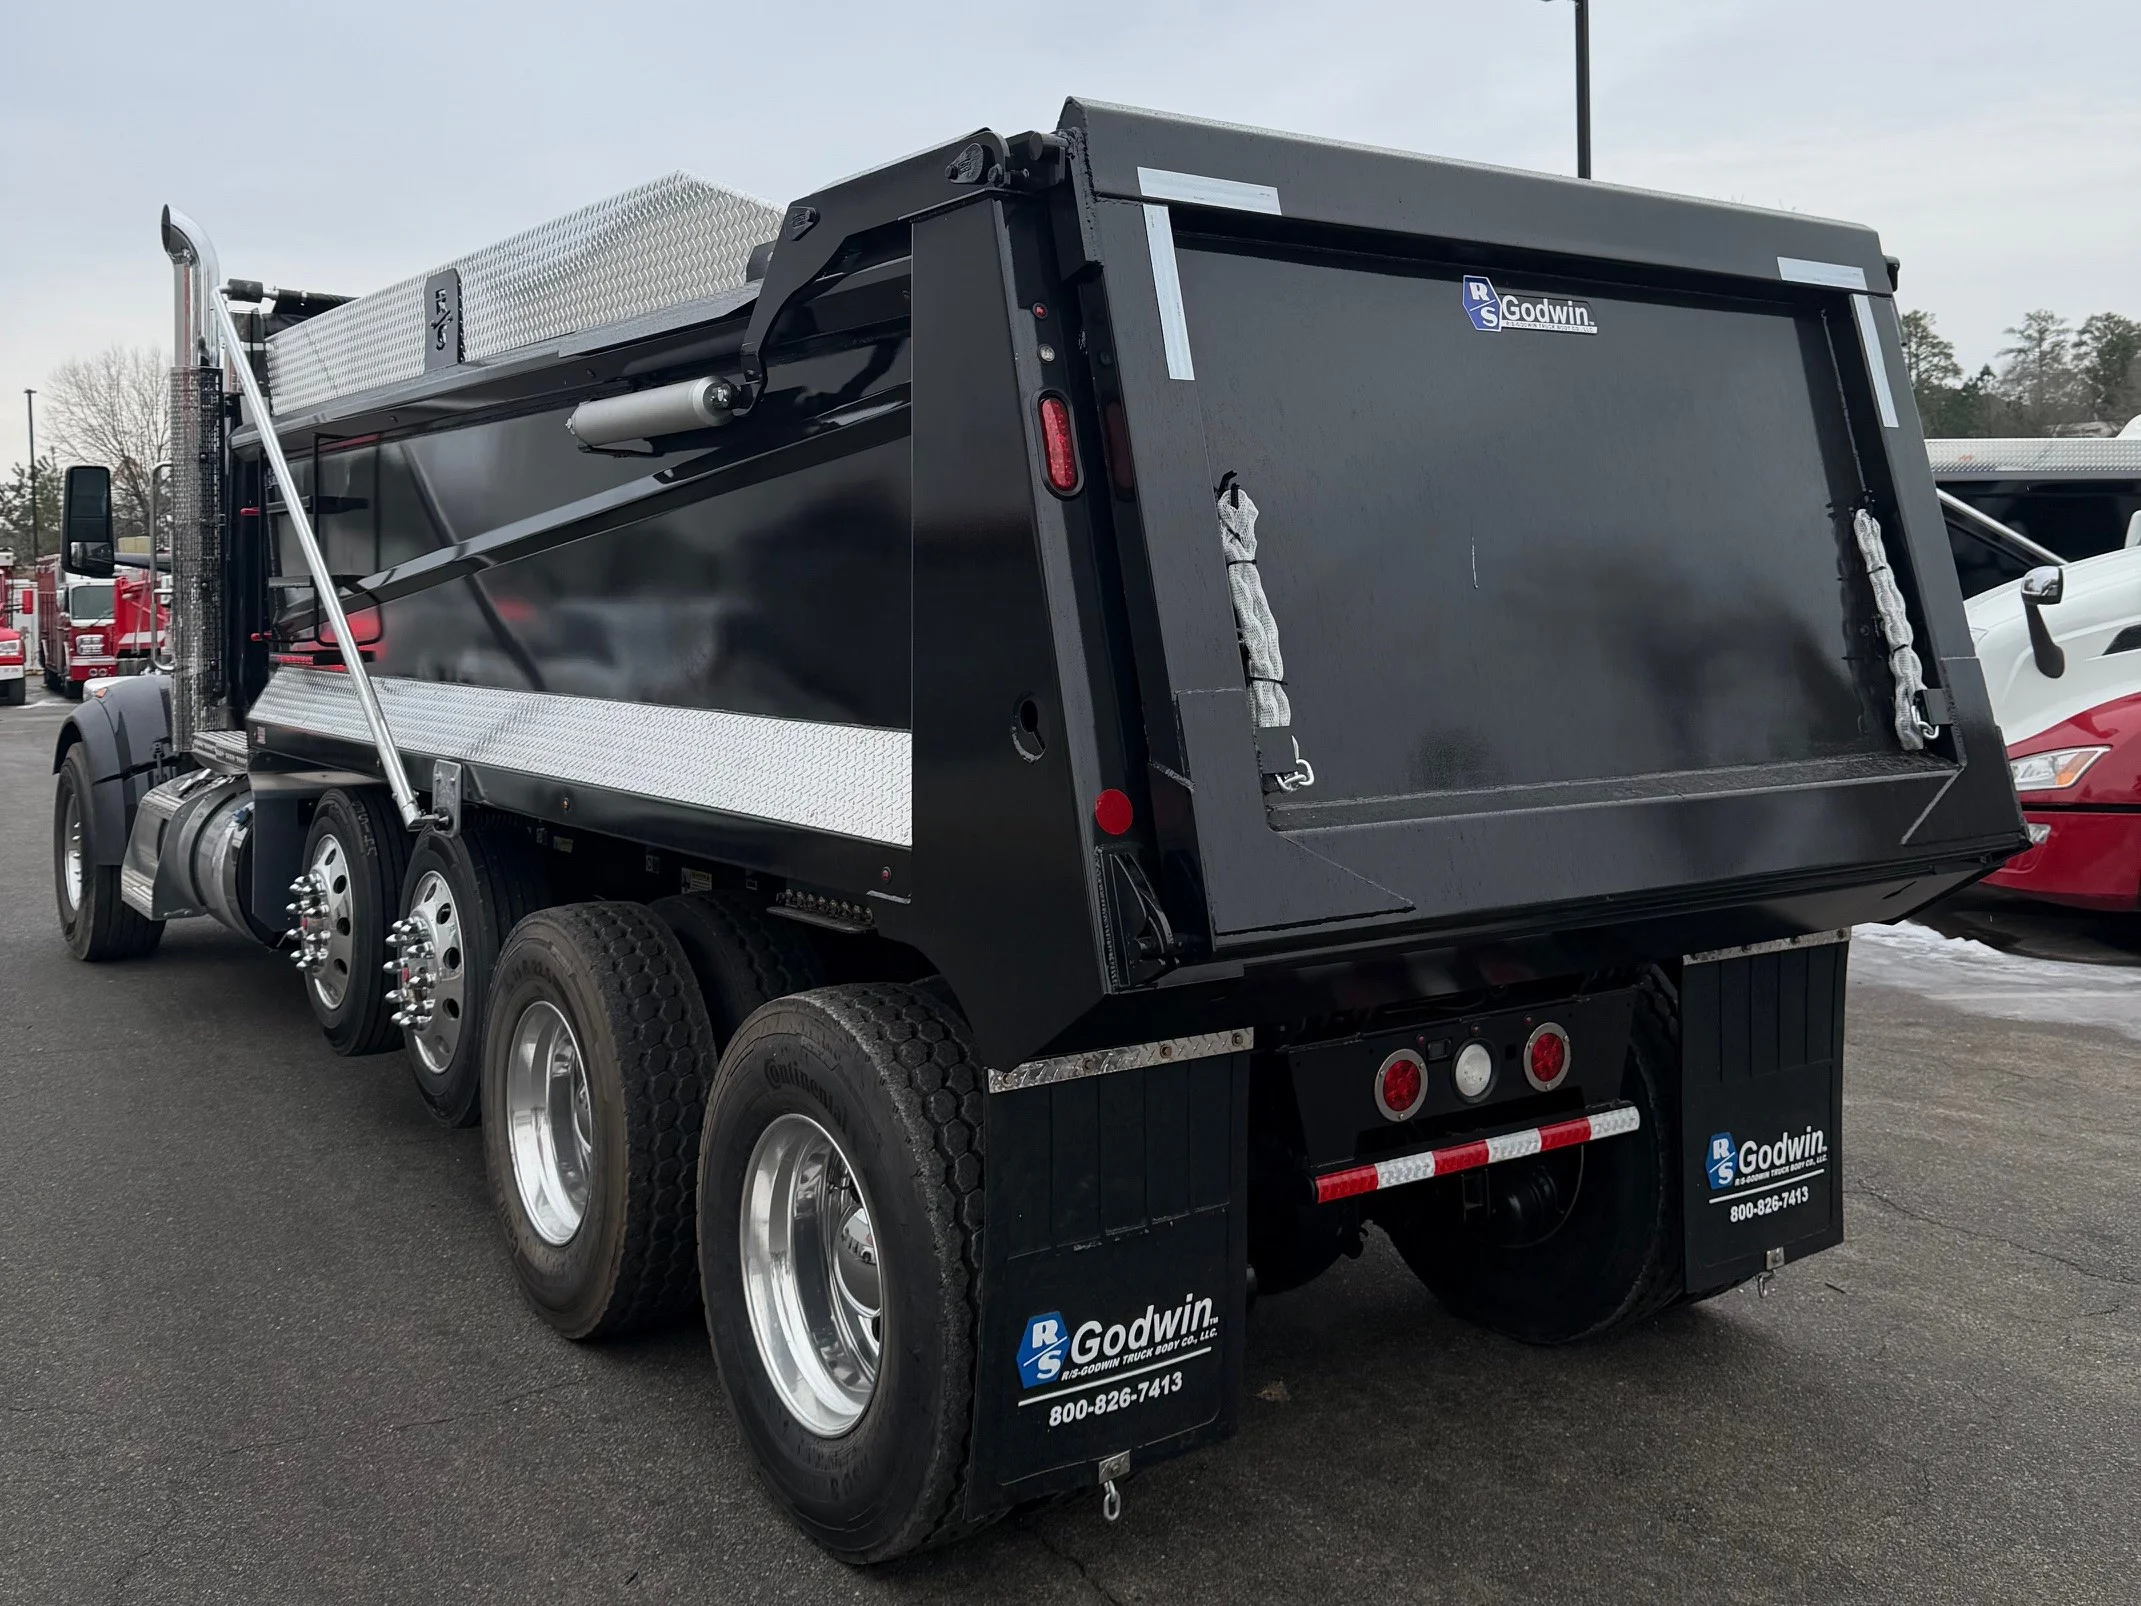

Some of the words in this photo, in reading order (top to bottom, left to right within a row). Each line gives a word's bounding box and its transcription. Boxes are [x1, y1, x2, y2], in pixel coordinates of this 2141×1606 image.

[1502, 295, 1589, 325] Godwin
[764, 1058, 847, 1133] Continental
[1738, 1125, 1824, 1174] Godwin
[1771, 1165, 1790, 1177] TRUCK
[1730, 1185, 1809, 1223] 800-826-7413
[1071, 1292, 1213, 1365] Godwin
[1061, 1357, 1120, 1382] R/S-GODWIN
[1122, 1347, 1154, 1366] TRUCK
[1154, 1338, 1180, 1356] BODY
[1199, 1328, 1218, 1341] LLC.
[1048, 1371, 1183, 1427] 800-826-7413
